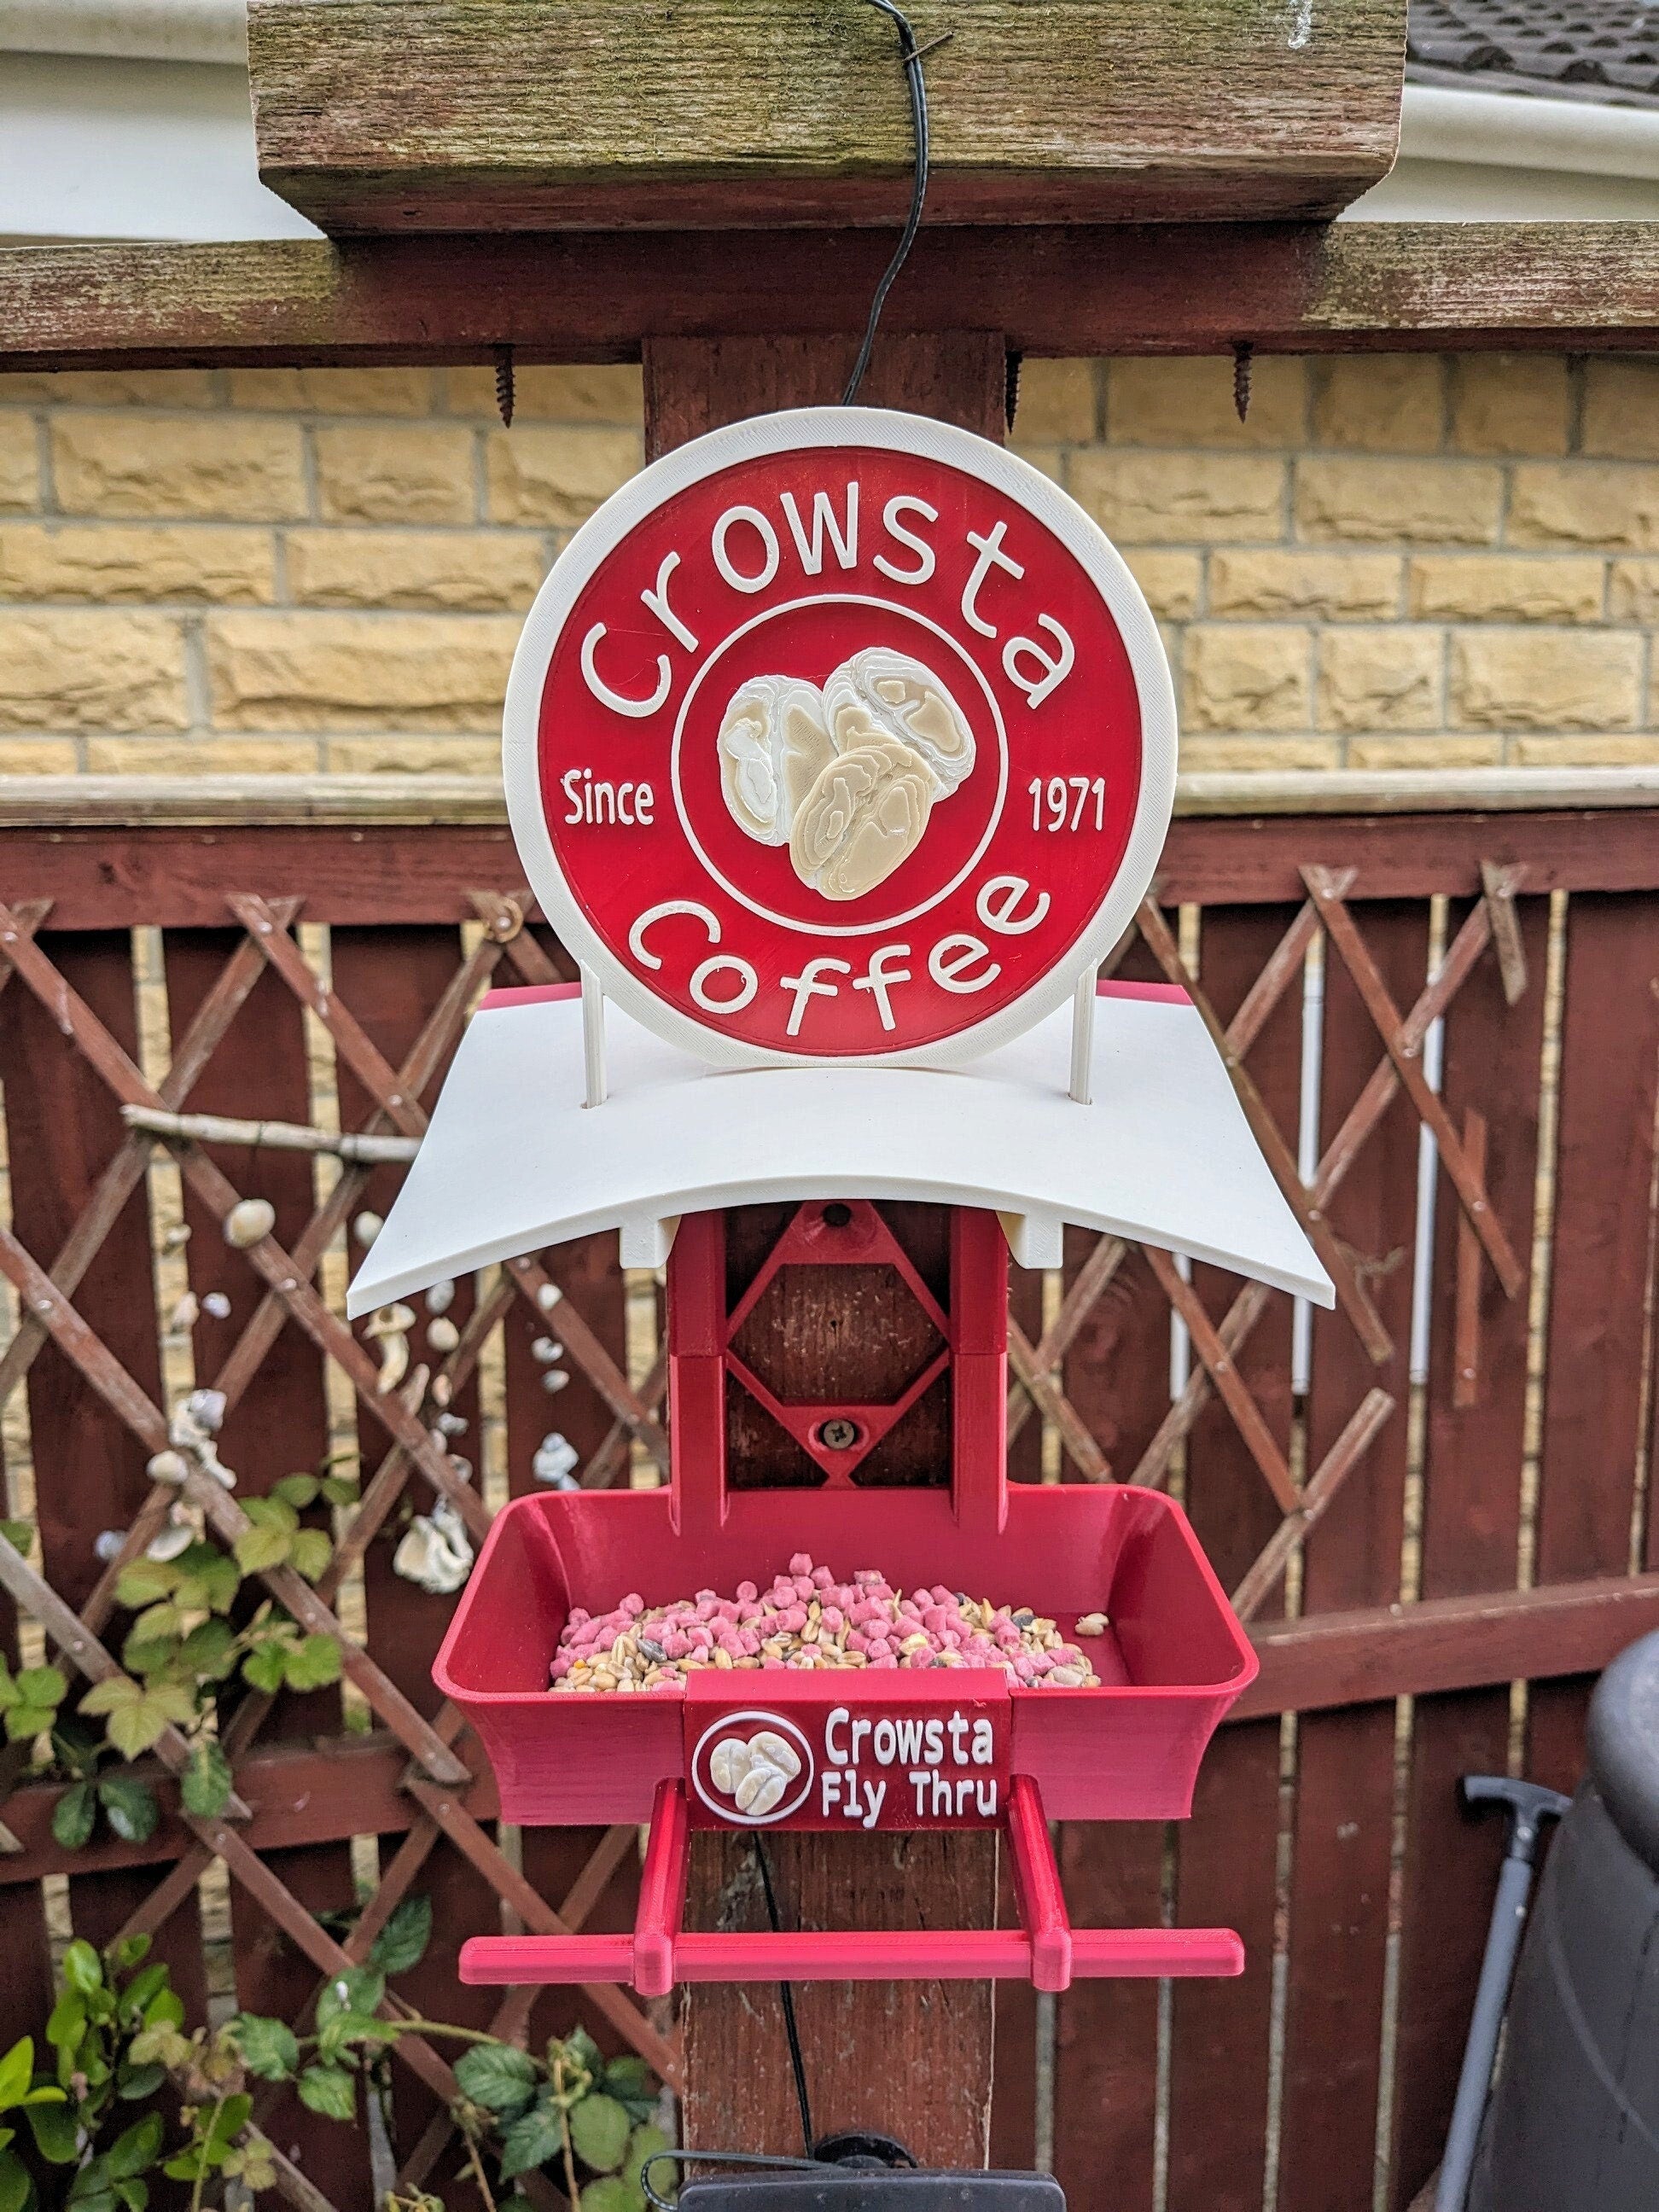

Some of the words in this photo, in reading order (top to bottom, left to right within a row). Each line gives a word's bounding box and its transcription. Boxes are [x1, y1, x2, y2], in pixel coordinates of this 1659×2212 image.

[581, 480, 1075, 718] Crowsta
[561, 769, 655, 826] Since
[1028, 776, 1107, 833] 1971
[627, 874, 1052, 1038] Coffee
[824, 1707, 994, 1766] Crowsta
[821, 1768, 887, 1829] Fly
[908, 1769, 998, 1817] Thru
